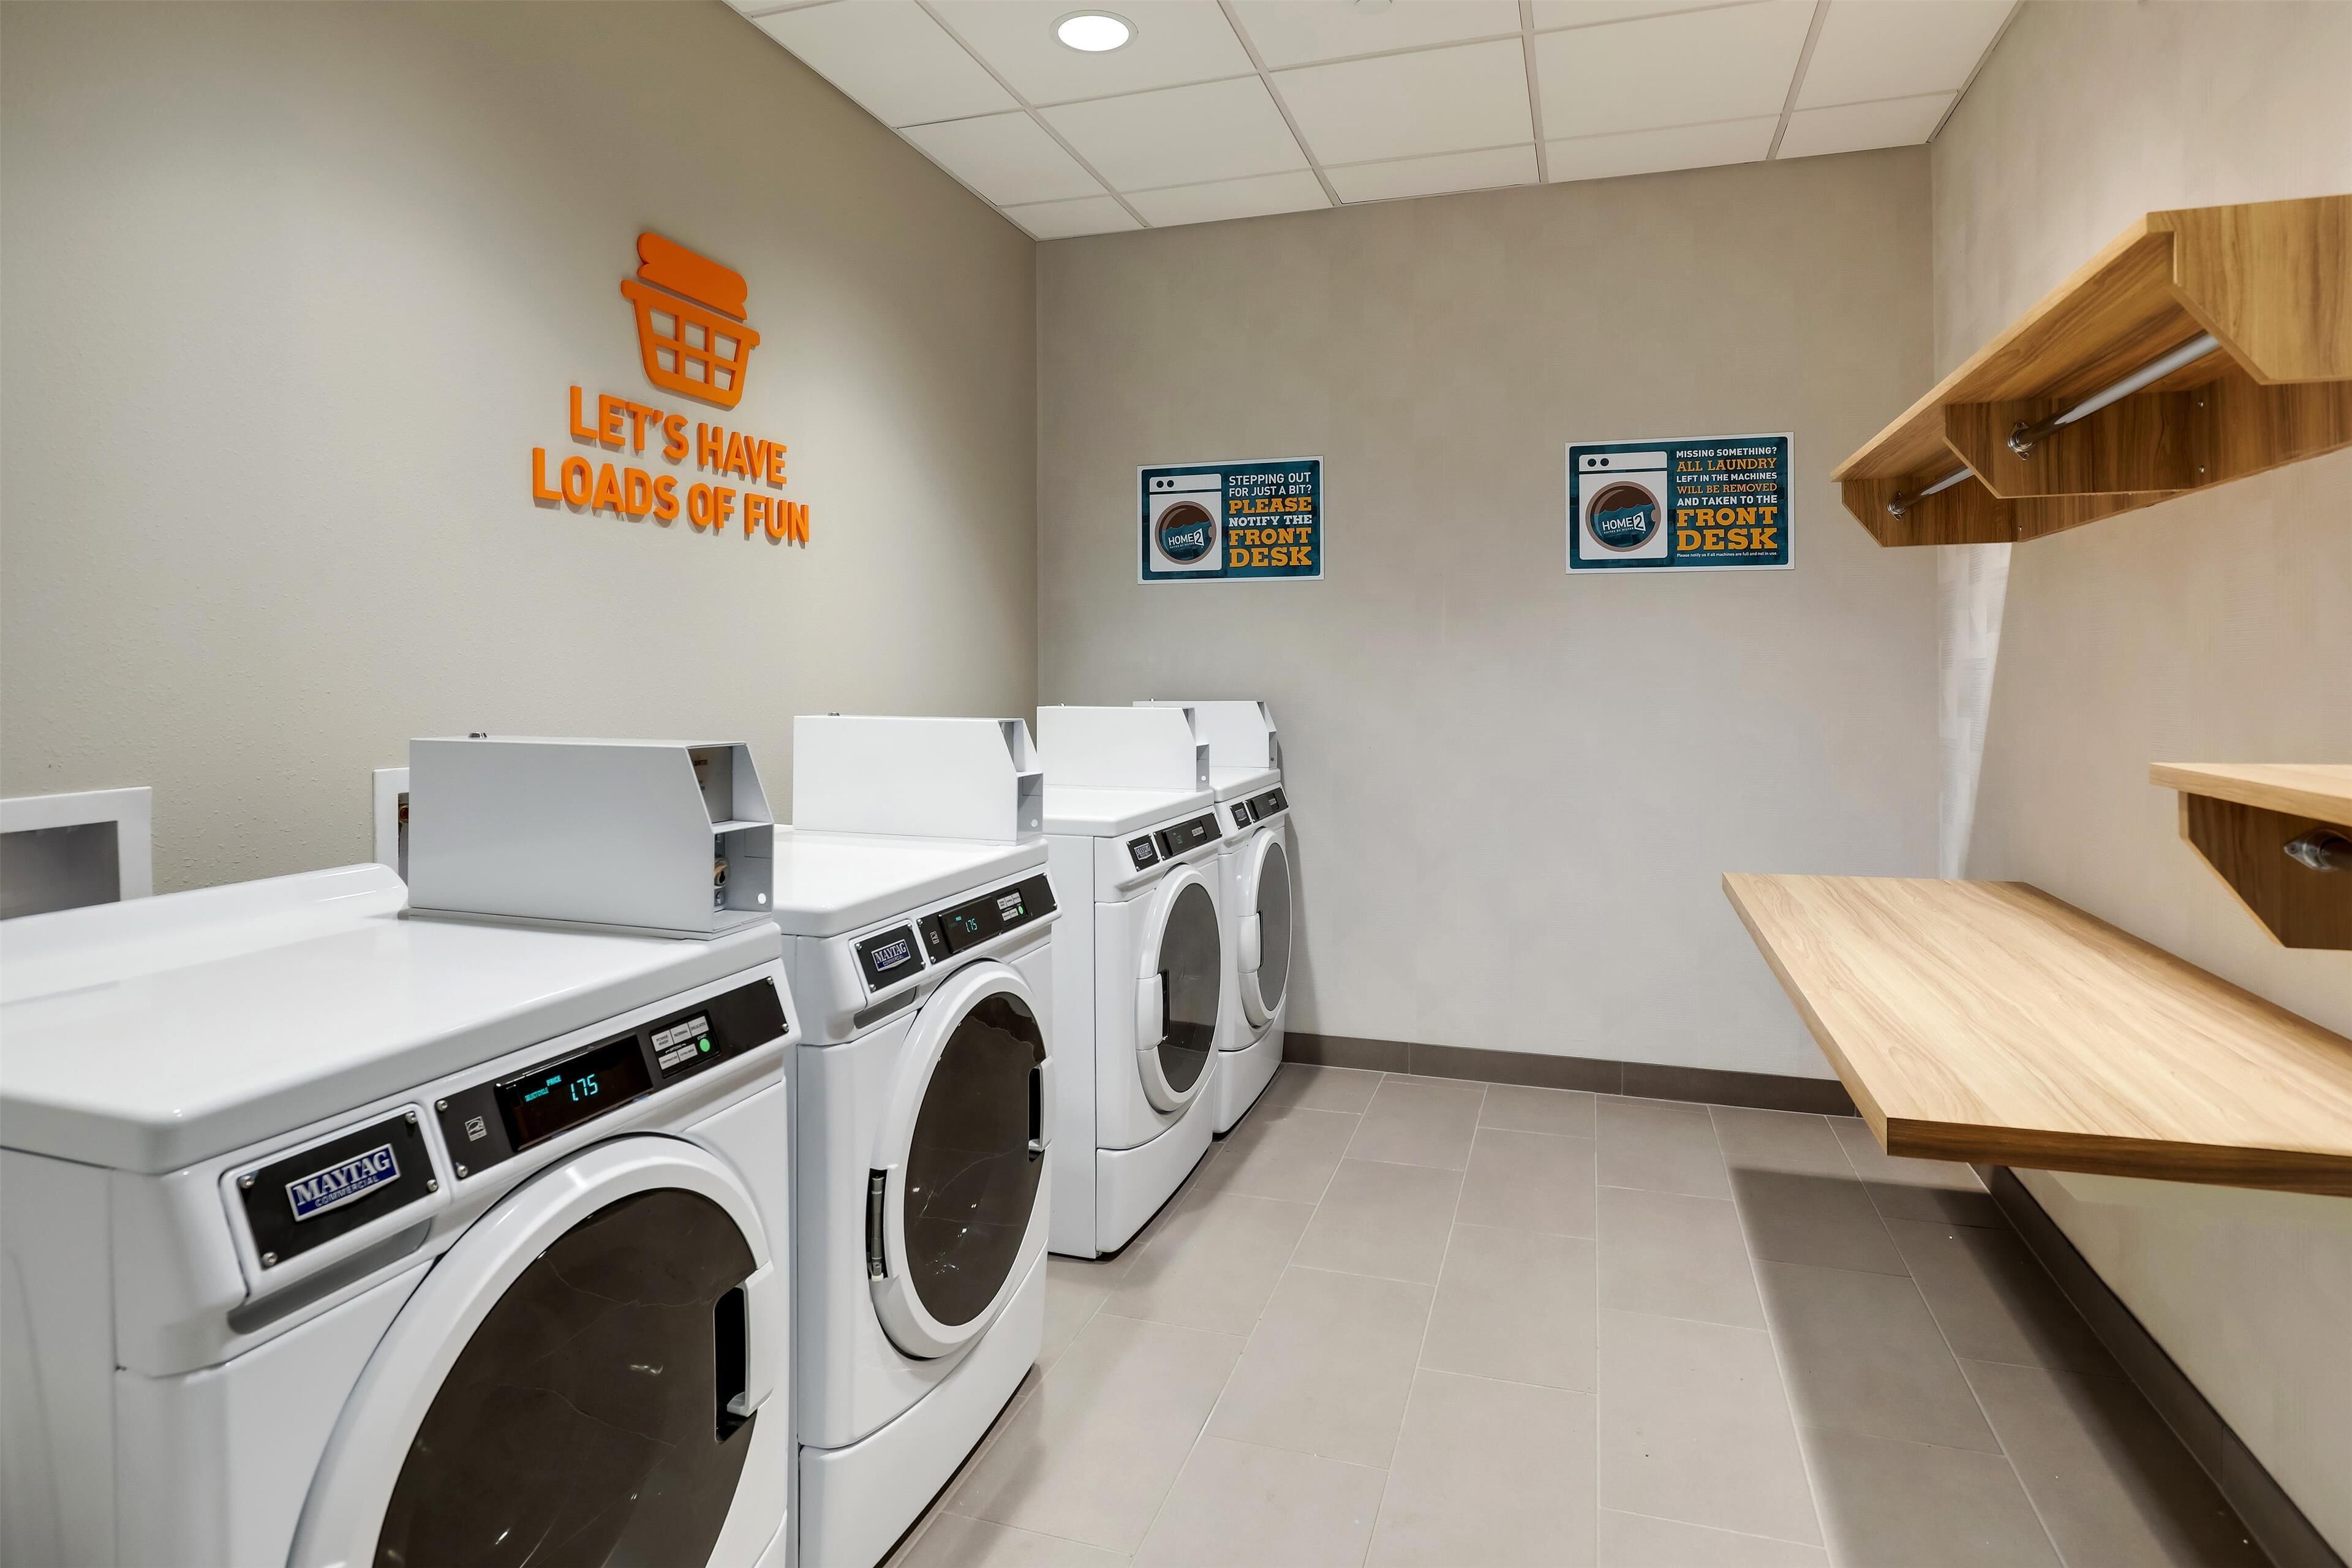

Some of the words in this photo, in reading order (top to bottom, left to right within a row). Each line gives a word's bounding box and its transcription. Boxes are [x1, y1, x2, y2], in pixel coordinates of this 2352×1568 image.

[570, 386, 689, 460] LET'S
[698, 423, 787, 484] HAVE
[1676, 450, 1714, 458] MISSING
[1716, 447, 1777, 456] SOMETHING?
[1676, 461, 1703, 472] ALL
[1708, 458, 1777, 470] LAUNDRY
[1229, 473, 1284, 486] STEPPING
[1288, 472, 1311, 483] OUT
[533, 448, 680, 521] LOADS
[688, 483, 736, 529] OF
[744, 494, 809, 543] FUN
[1229, 488, 1249, 497] FOR
[1251, 486, 1277, 496] JUST
[1278, 486, 1286, 495] A
[1289, 484, 1311, 494] BIT?
[1676, 485, 1703, 494] WILL
[1706, 484, 1720, 493] BE
[1722, 483, 1777, 492] REMOVED
[1229, 497, 1311, 514] PLEASE
[1676, 497, 1699, 506] AND
[1702, 496, 1737, 505] TAKEN
[1740, 496, 1754, 504] TO
[1756, 495, 1777, 503] THE
[1229, 516, 1280, 527] NOTIFY
[1283, 514, 1312, 525] THE
[1676, 507, 1777, 527] FRONT
[1229, 527, 1312, 546] FRONT
[1676, 527, 1777, 551] DESK
[1229, 546, 1313, 568] DESK
[875, 943, 907, 963] MAYTAG
[546, 1075, 562, 1087] PRICE
[292, 1151, 391, 1206] MAYTAG
[315, 1175, 380, 1207] COMMERCIAL
